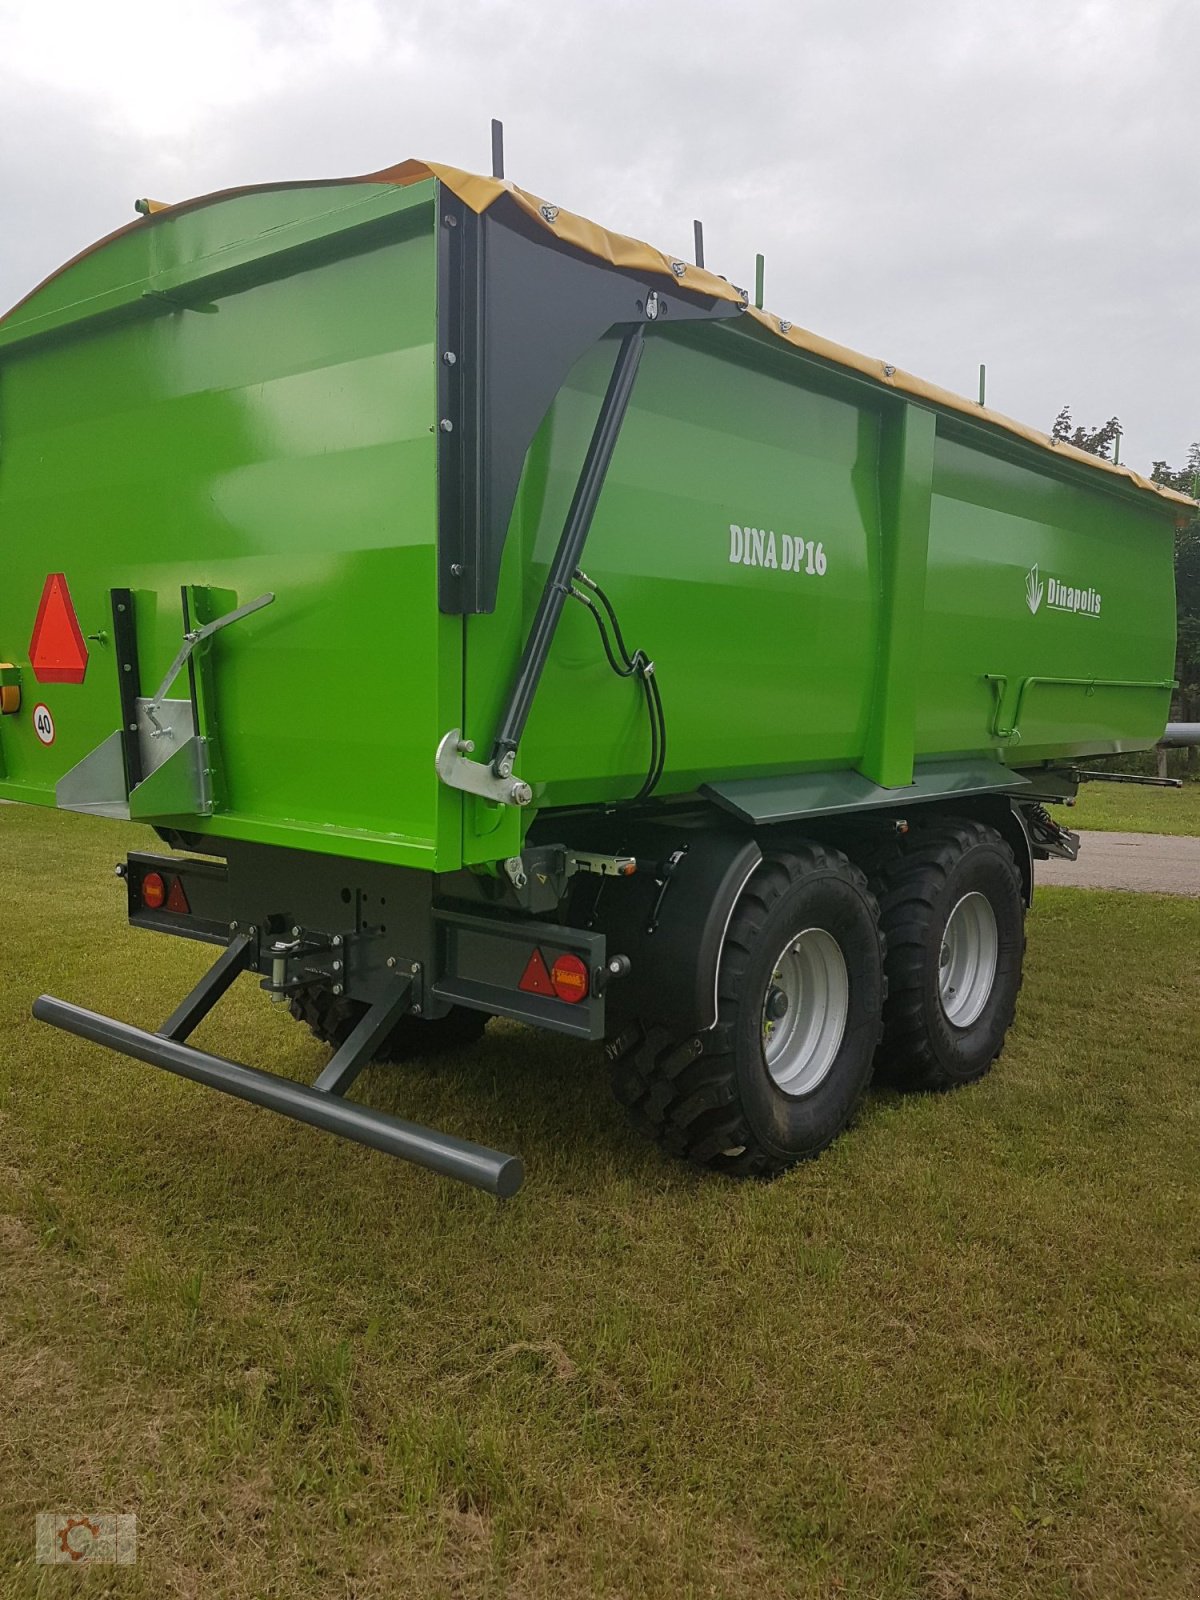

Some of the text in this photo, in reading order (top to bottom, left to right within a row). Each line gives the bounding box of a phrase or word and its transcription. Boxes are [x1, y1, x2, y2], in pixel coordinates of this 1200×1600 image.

[729, 524, 827, 576] DINA DP16
[1047, 577, 1101, 614] Dinapolis
[37, 714, 51, 734] 40
